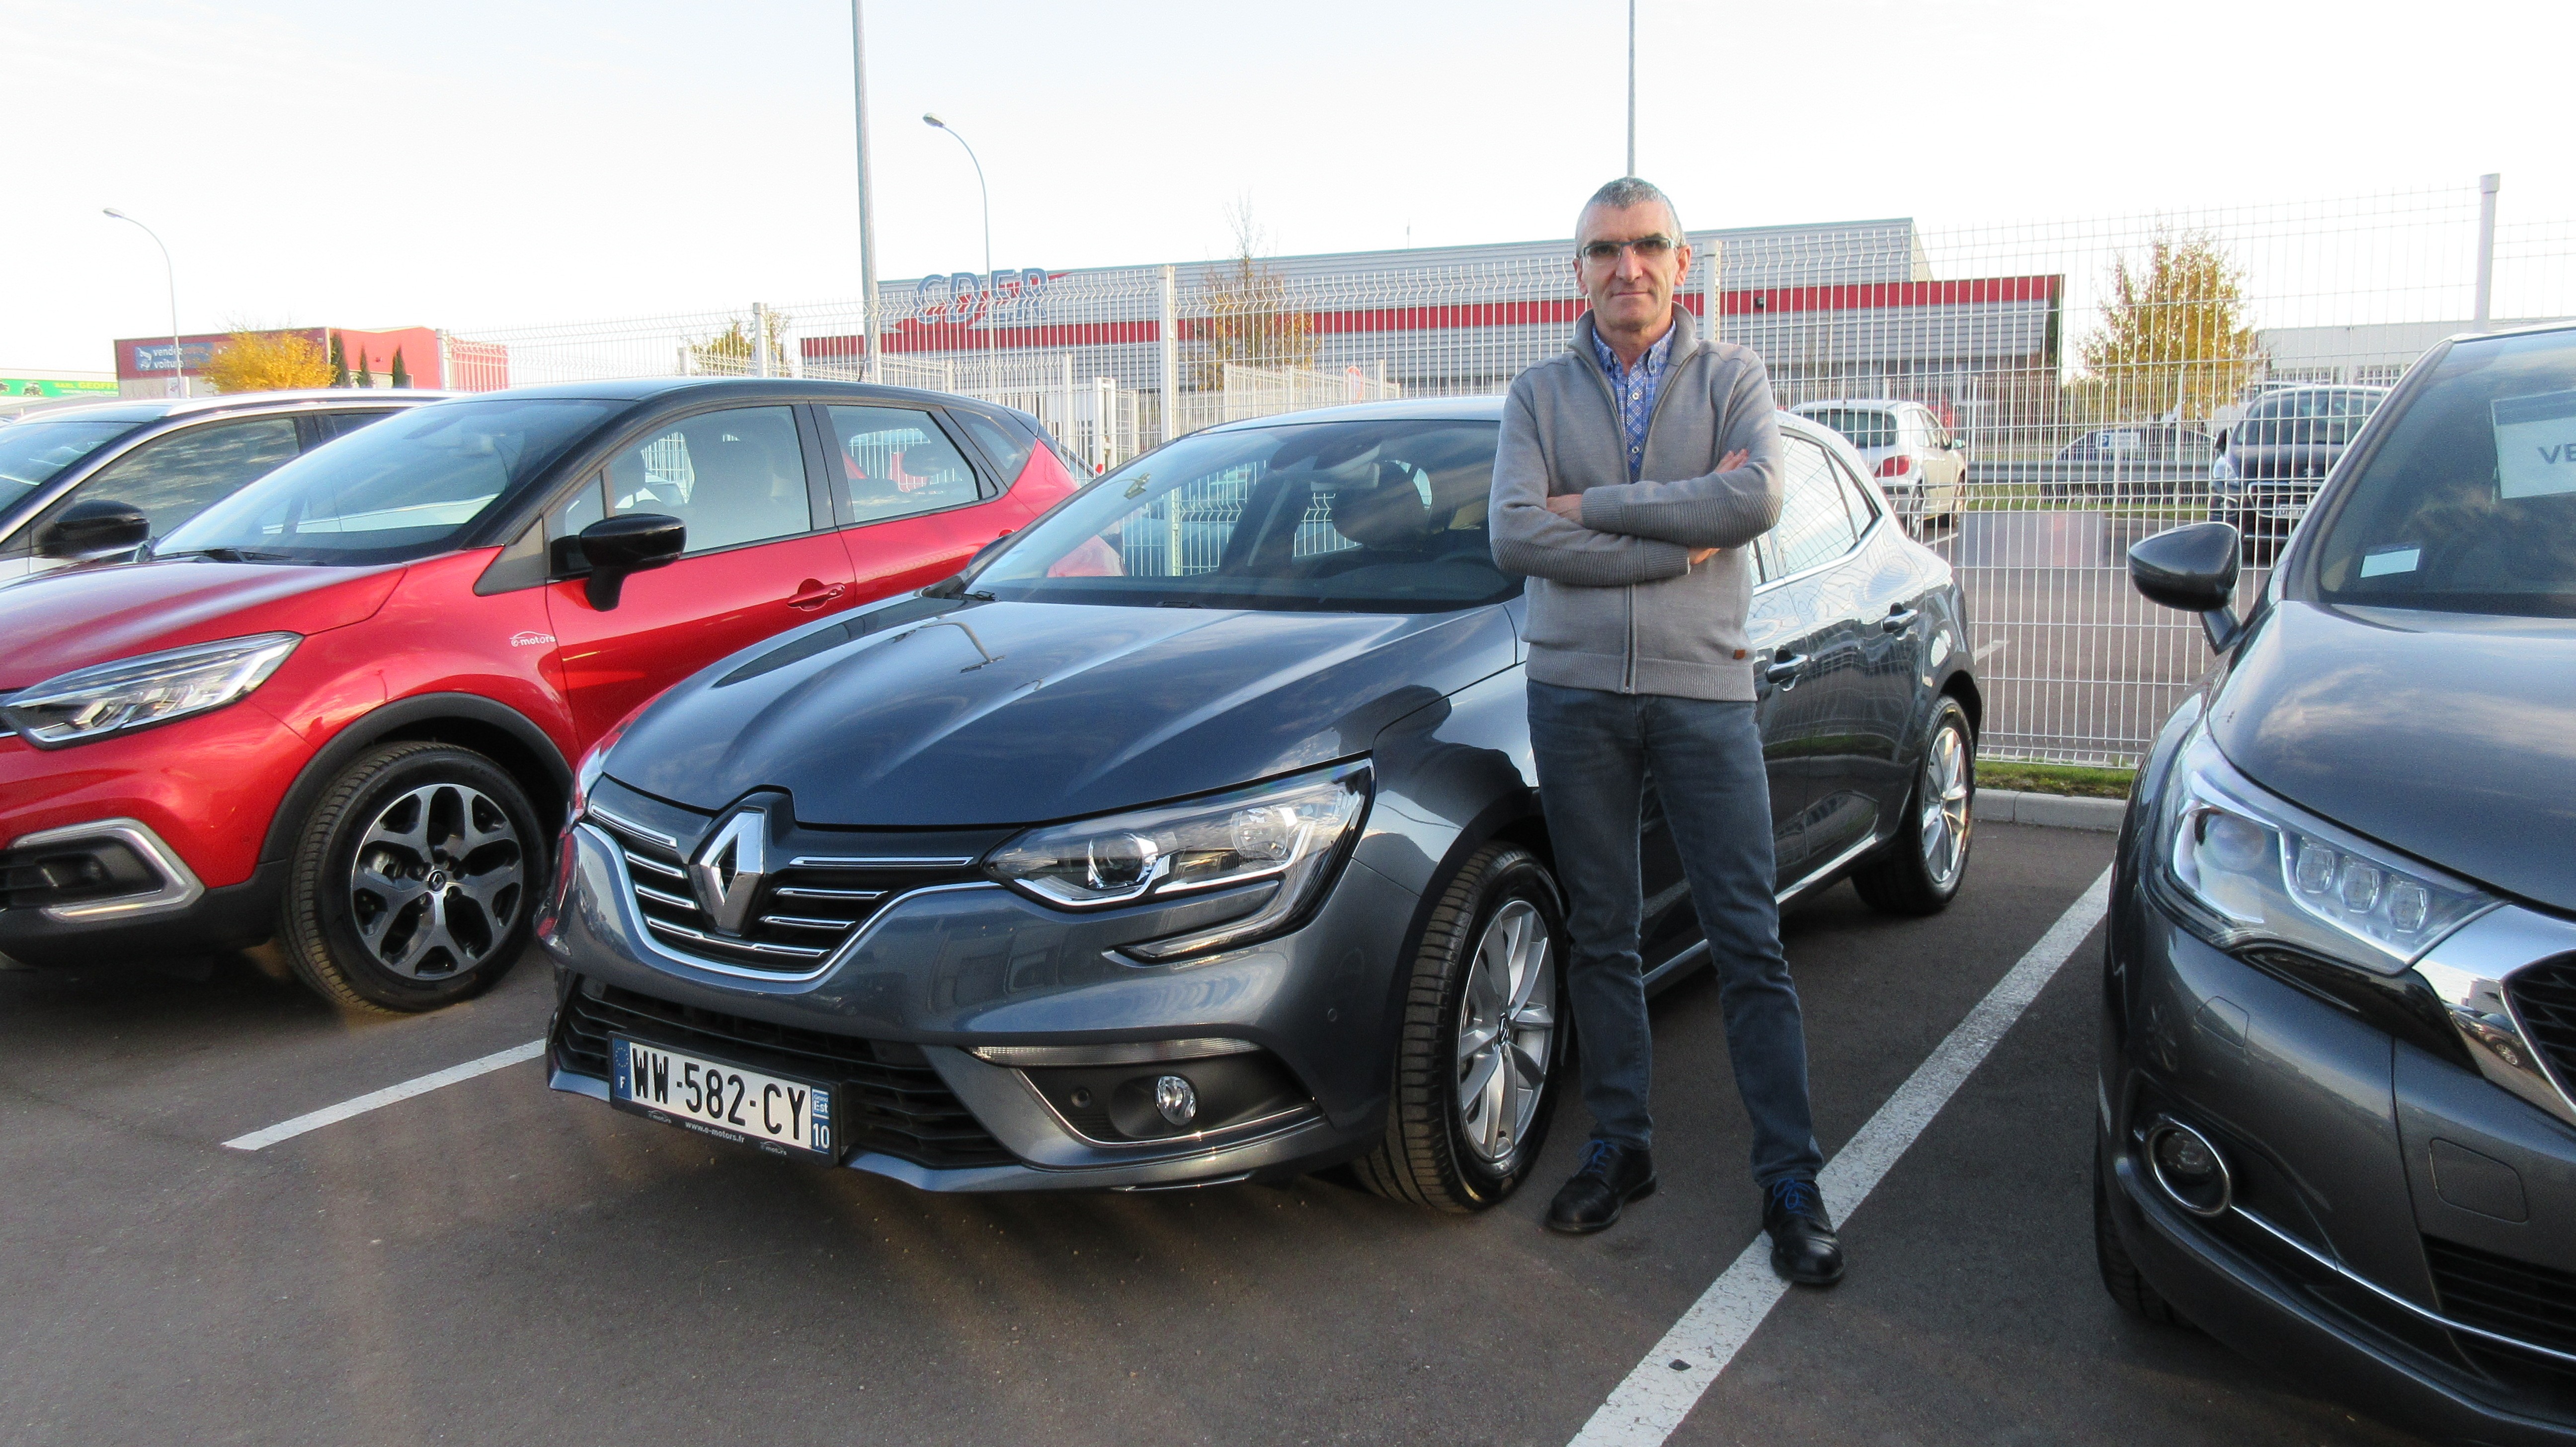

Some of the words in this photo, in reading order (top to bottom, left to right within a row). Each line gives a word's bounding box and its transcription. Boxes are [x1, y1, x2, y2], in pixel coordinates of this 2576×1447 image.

[913, 268, 1048, 324] CDER
[2537, 443, 2576, 464] VE
[620, 1075, 626, 1089] F
[814, 1100, 828, 1113] Est
[685, 1121, 745, 1143] www.e-motors.fr
[813, 1123, 830, 1149] 10
